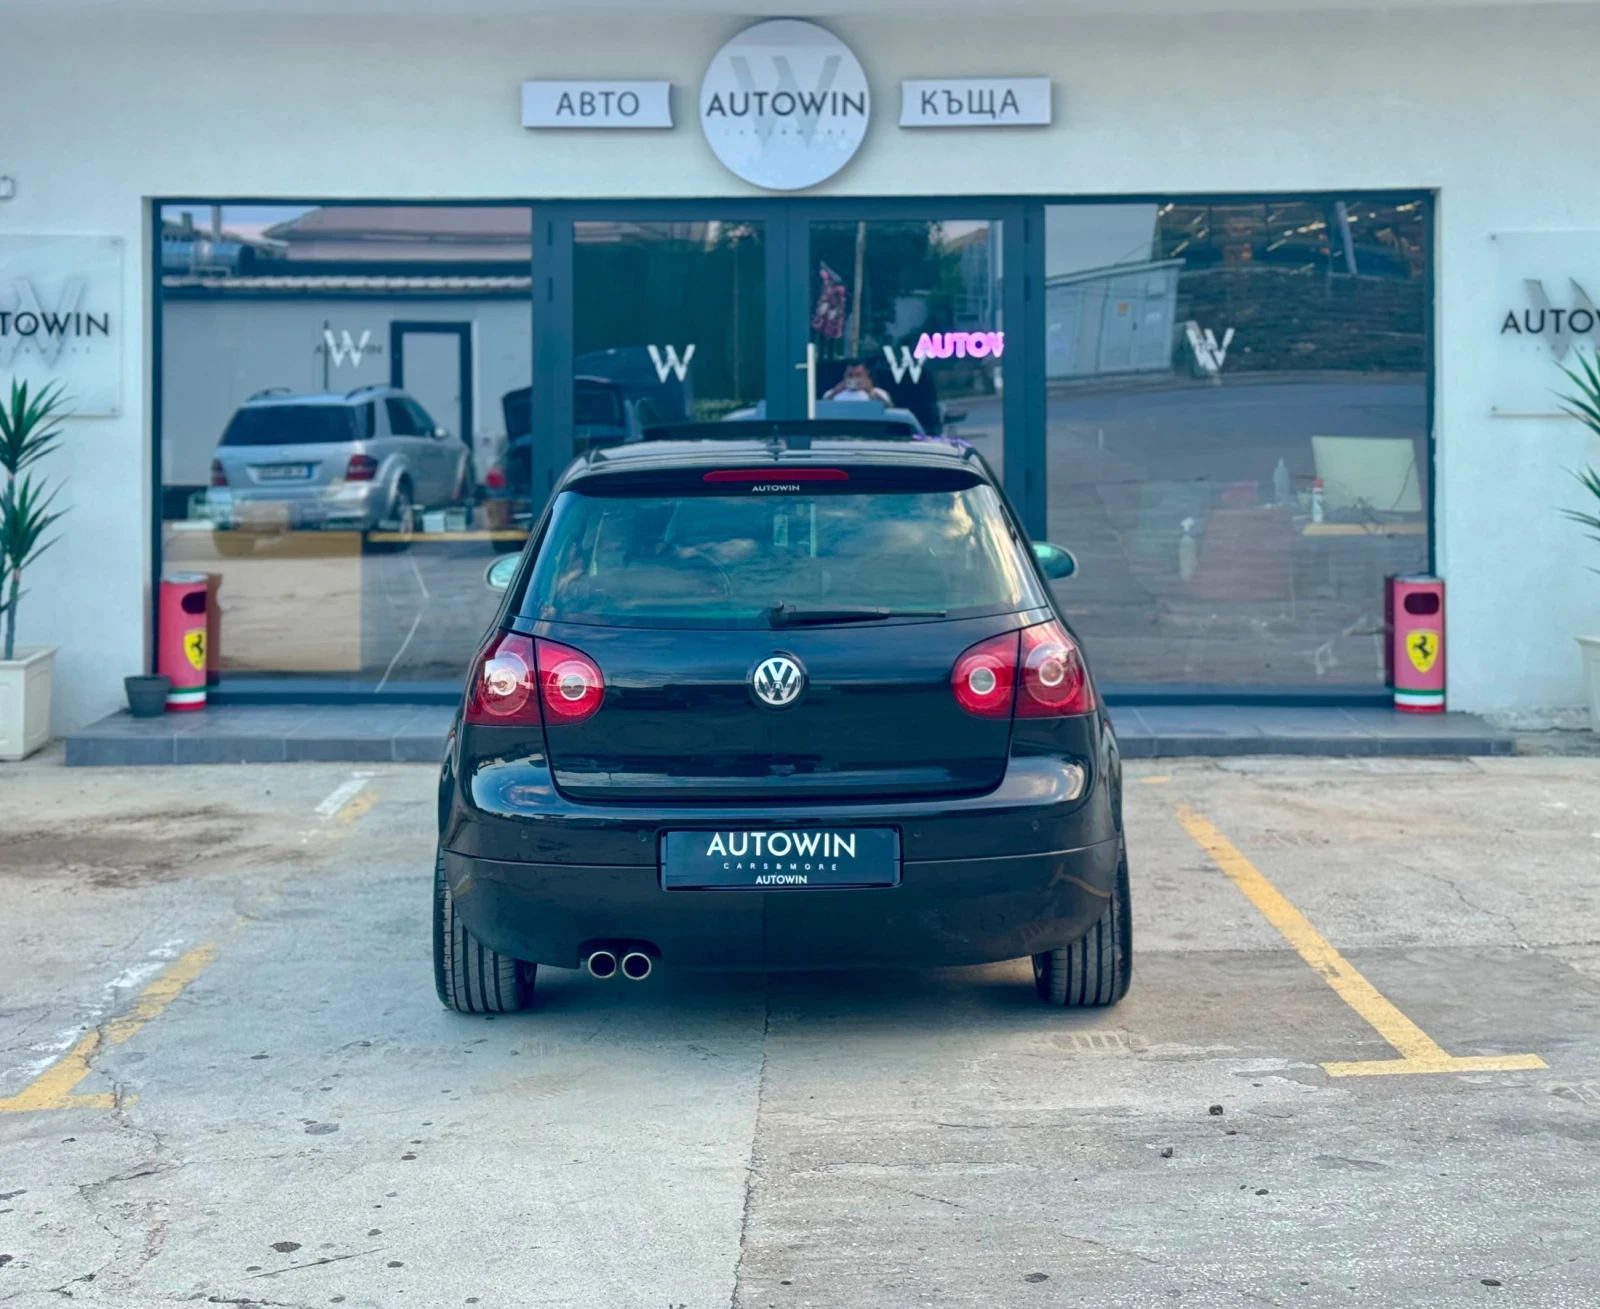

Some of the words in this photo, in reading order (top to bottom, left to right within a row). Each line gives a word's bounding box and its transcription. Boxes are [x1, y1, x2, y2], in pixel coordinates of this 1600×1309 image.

[556, 91, 640, 116] АВТО
[706, 91, 865, 117] AUTOWIN
[921, 88, 1020, 120] КЪЩА
[1500, 308, 1600, 334] AUTO
[323, 329, 372, 368] W
[647, 344, 696, 384] W
[752, 484, 800, 492] AUTOWIN
[706, 832, 856, 858] AUTOWIN
[723, 862, 837, 871] CARS&MORE
[755, 874, 808, 885] AUTOWIN
